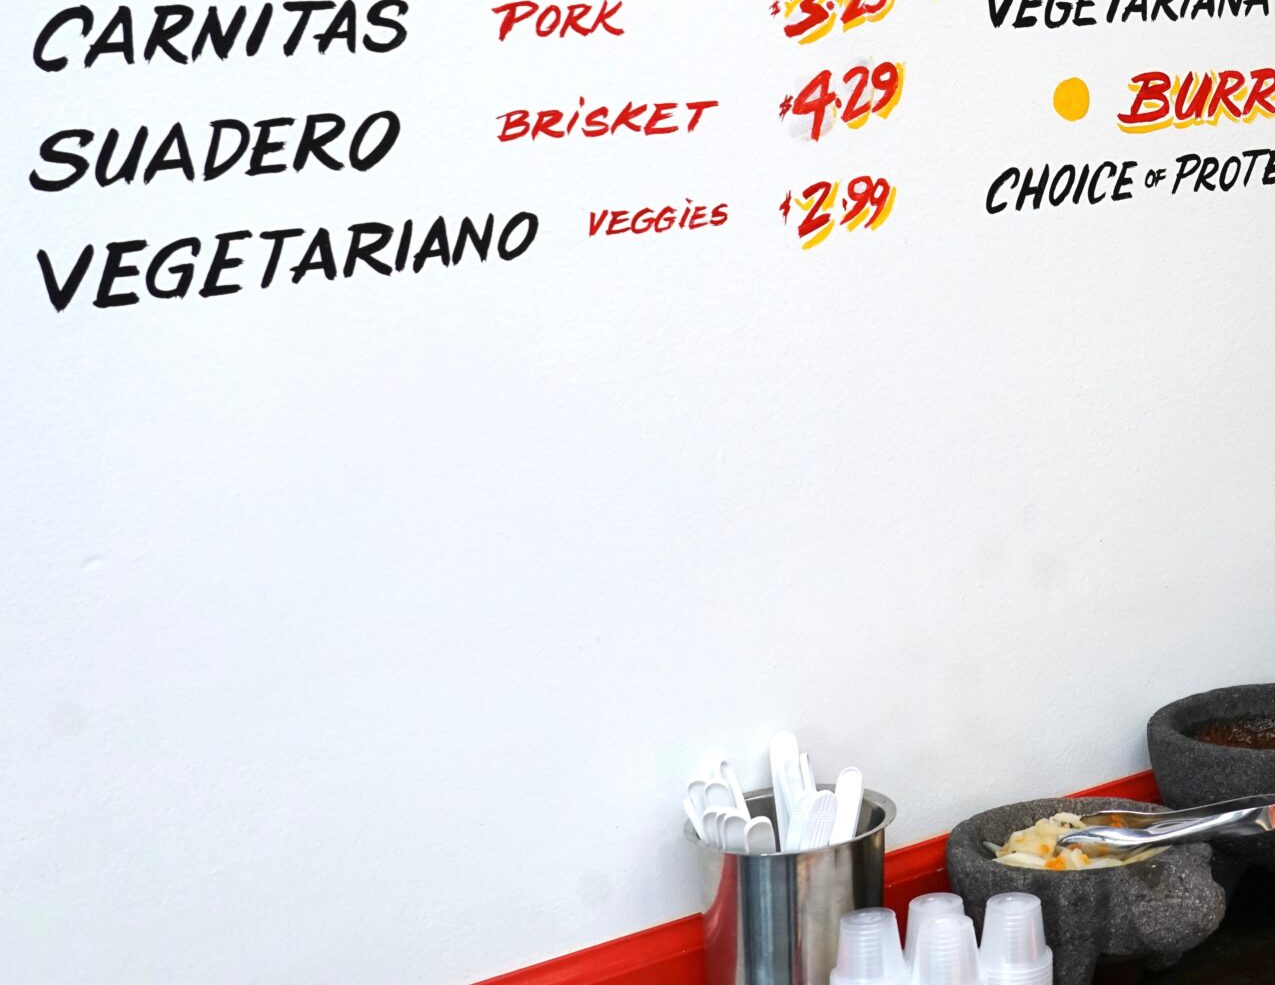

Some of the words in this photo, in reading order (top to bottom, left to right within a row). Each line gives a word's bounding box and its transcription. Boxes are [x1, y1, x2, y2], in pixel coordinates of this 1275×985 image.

[33, 0, 408, 72] CARNITAS
[492, 0, 624, 40] PORK
[29, 111, 400, 192] SUADERO
[780, 62, 900, 145] $4.29
[986, 161, 1137, 214] CHOICE
[37, 212, 539, 312] VEGETARIANO
[780, 176, 893, 241] $2.99
